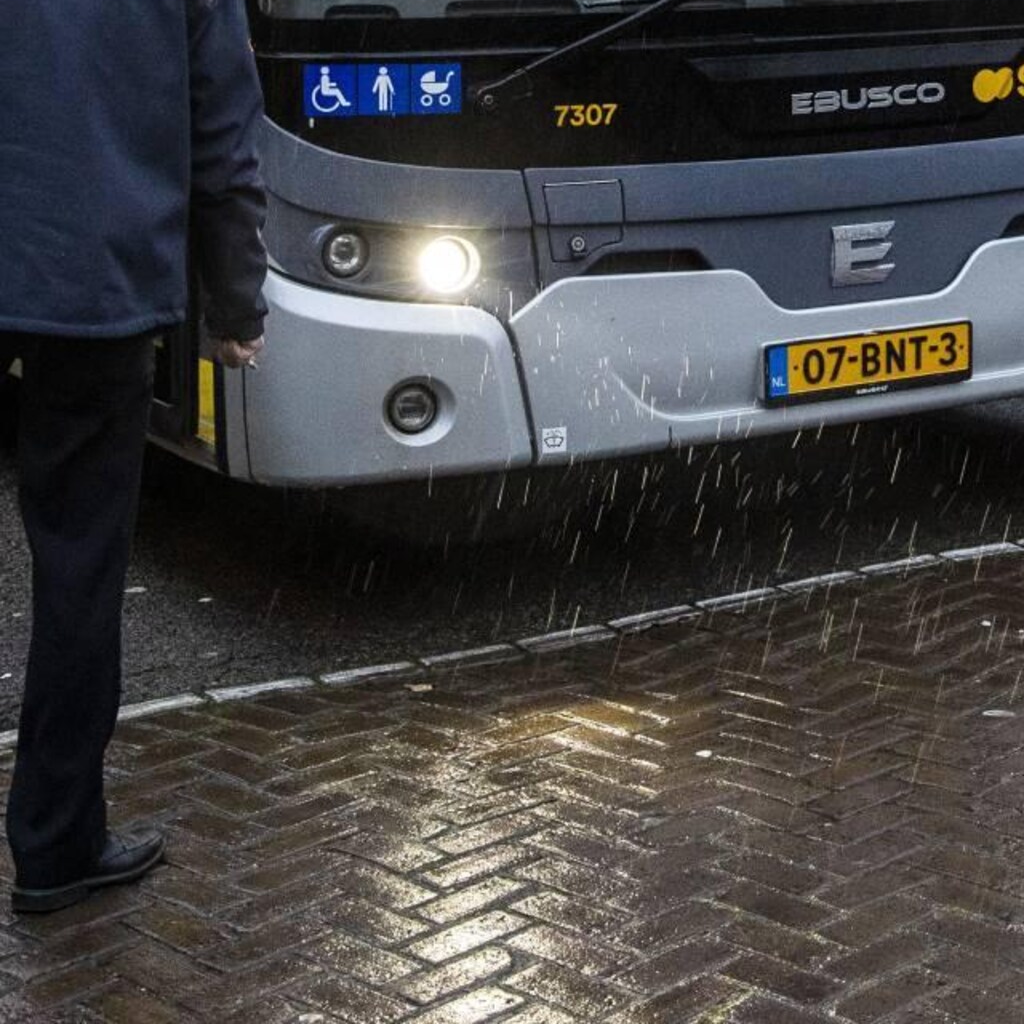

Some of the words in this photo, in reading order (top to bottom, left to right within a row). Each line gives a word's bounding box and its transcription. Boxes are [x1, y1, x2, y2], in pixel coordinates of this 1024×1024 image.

[791, 82, 945, 115] EBUSCO
[554, 103, 618, 128] 7307
[802, 332, 958, 385] 07-BNT-3
